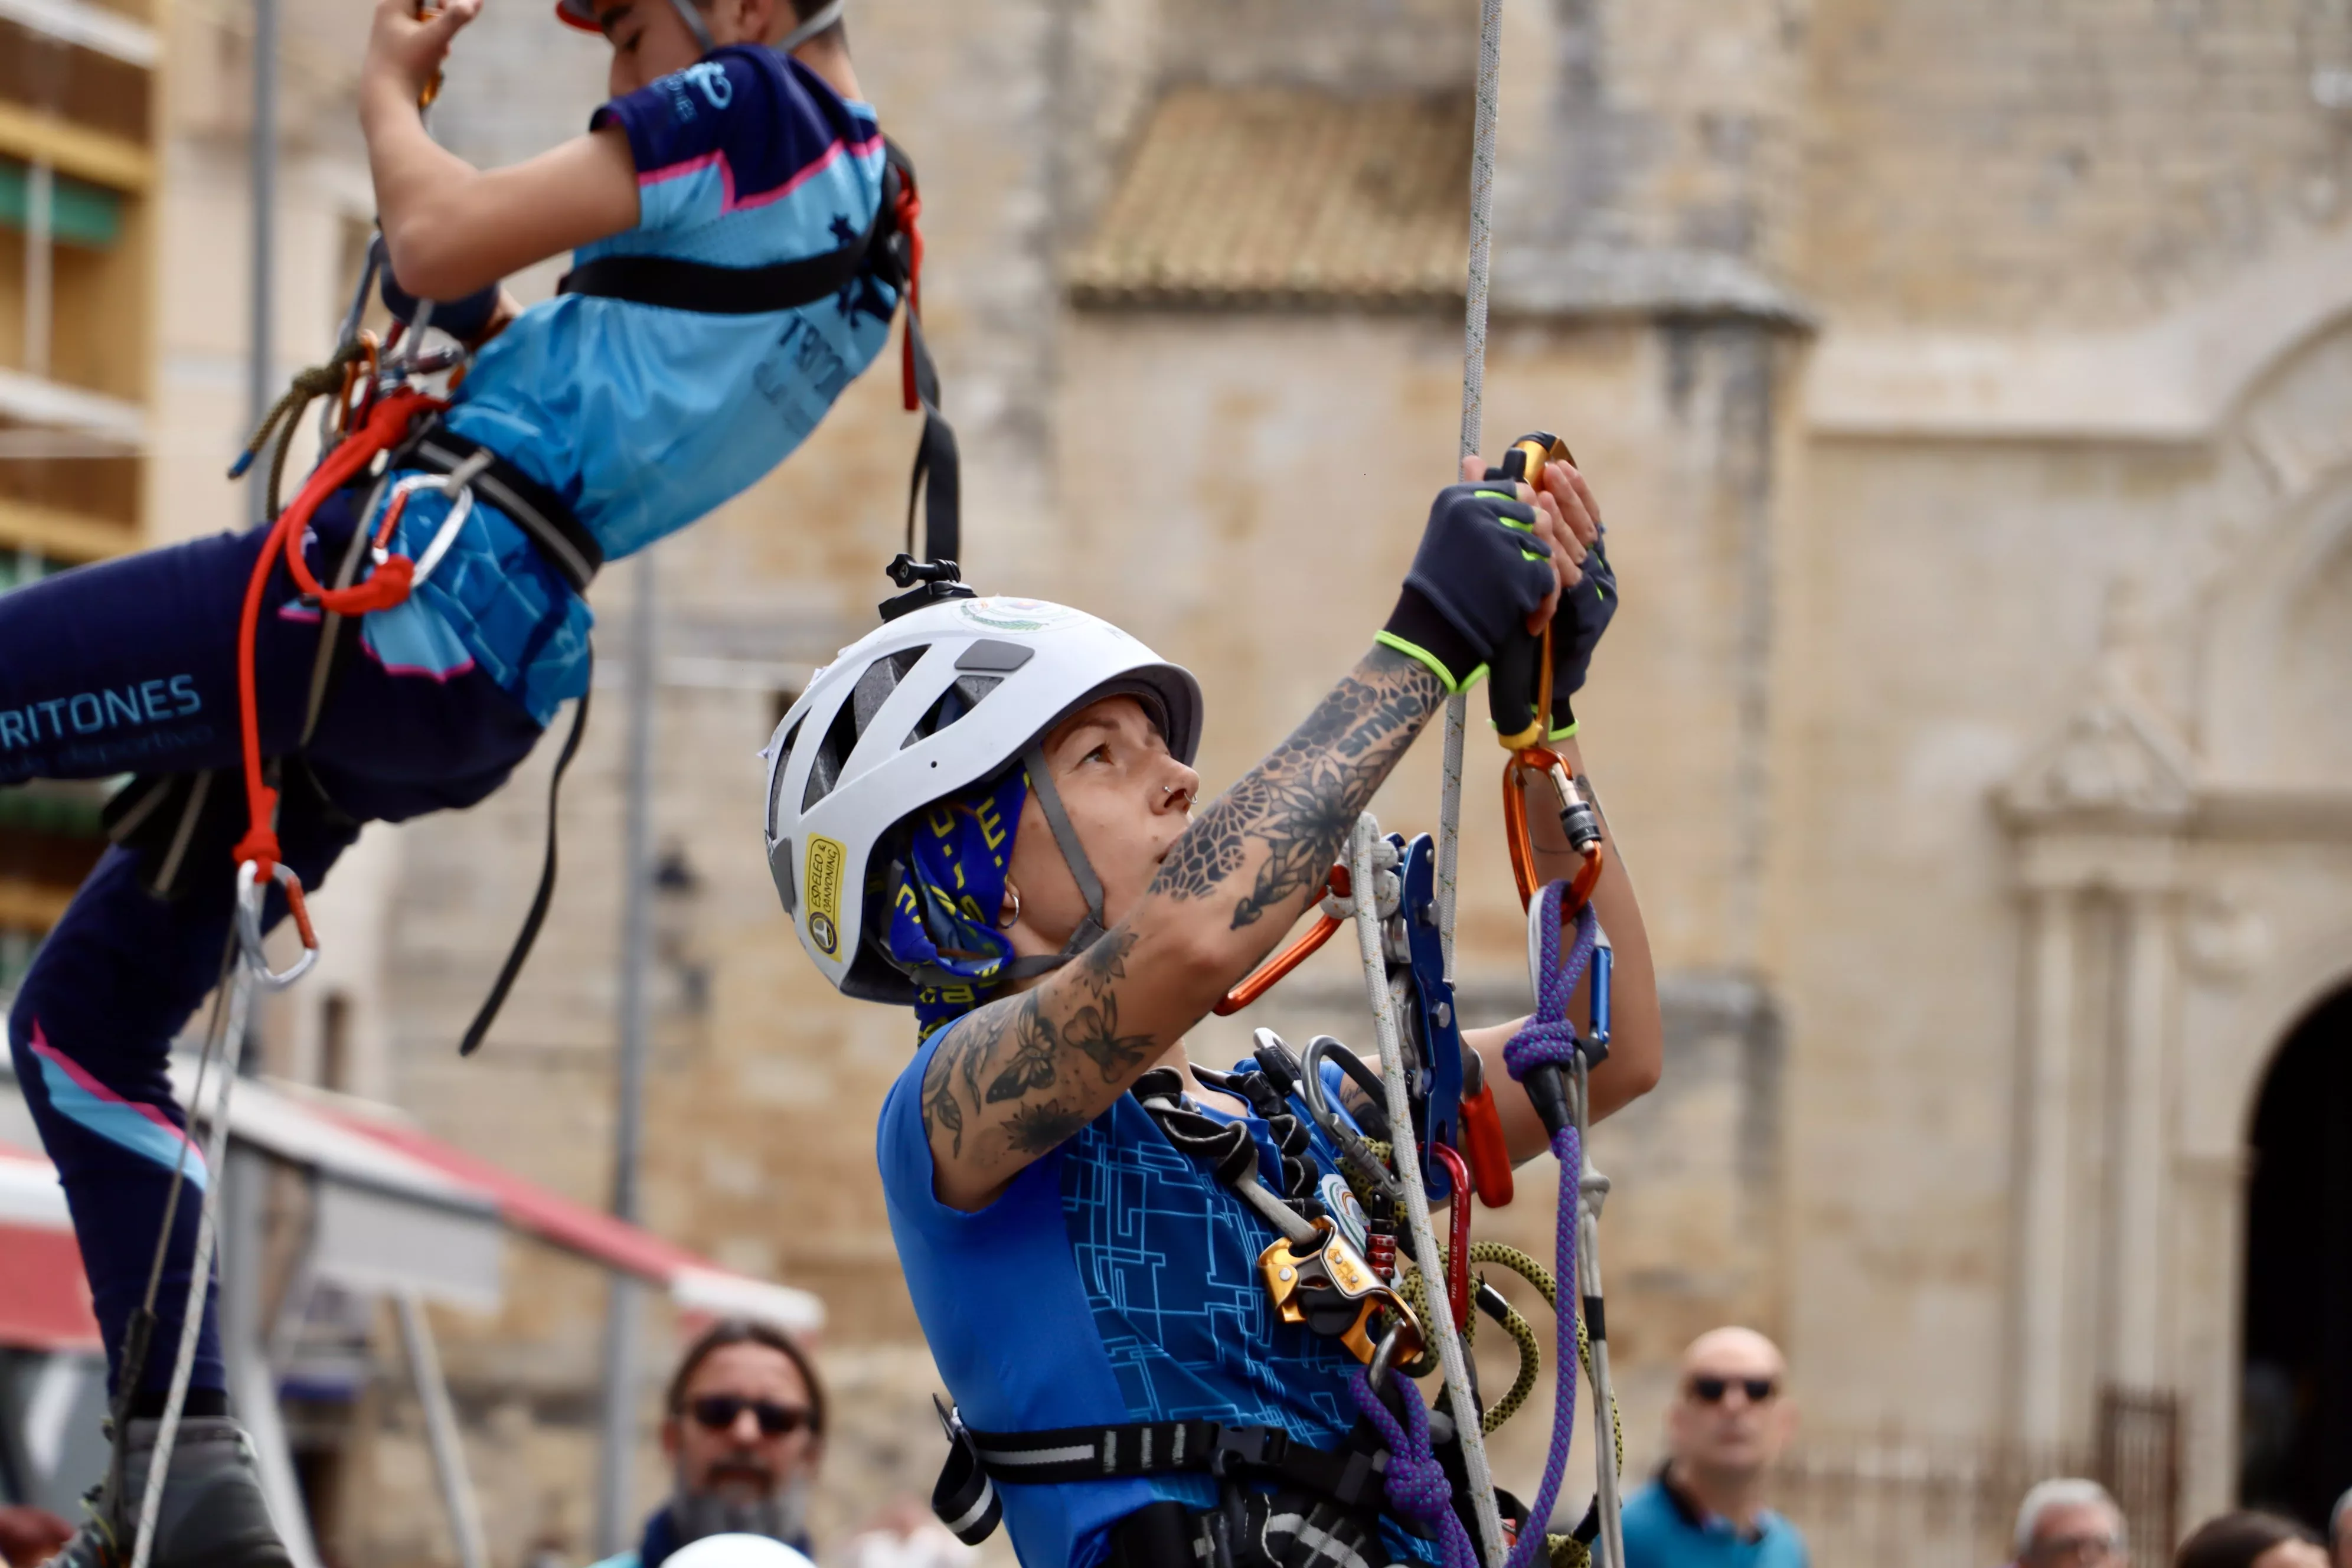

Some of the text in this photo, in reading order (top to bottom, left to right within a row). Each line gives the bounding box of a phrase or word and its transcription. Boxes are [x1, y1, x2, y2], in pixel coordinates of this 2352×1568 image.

[811, 844, 827, 908] ESPELEO &
[823, 848, 838, 913] CANYONING
